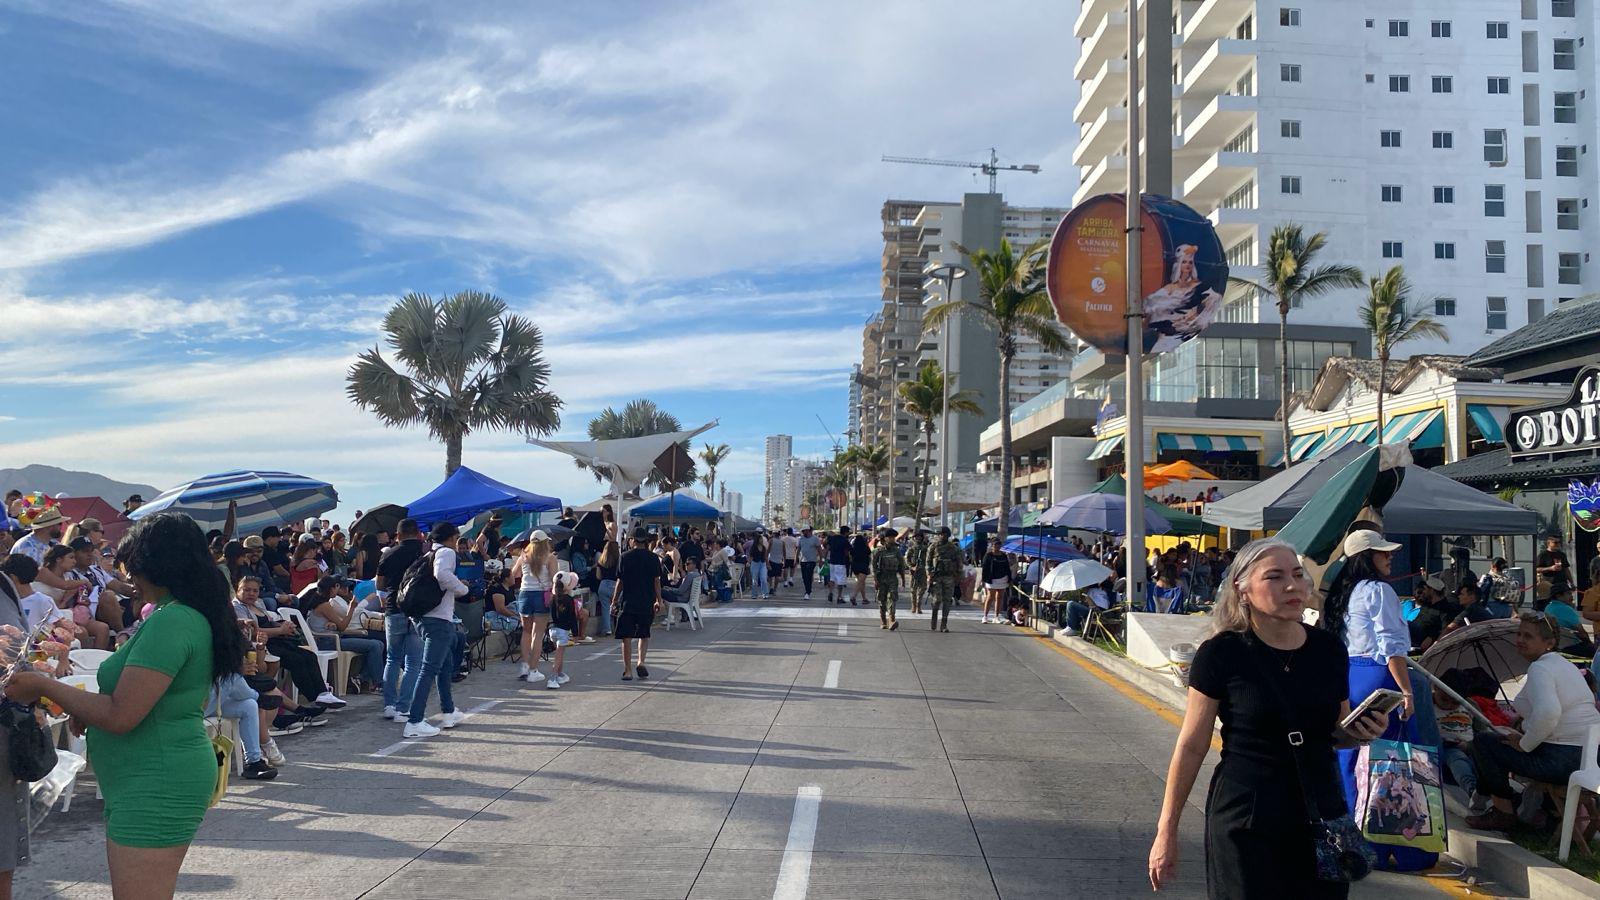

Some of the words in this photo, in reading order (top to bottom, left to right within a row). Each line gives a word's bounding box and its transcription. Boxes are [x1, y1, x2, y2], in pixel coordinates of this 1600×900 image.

[1083, 217, 1114, 228] ARRIBA
[1077, 237, 1120, 248] CARNAVAL
[1540, 403, 1600, 446] BOT
